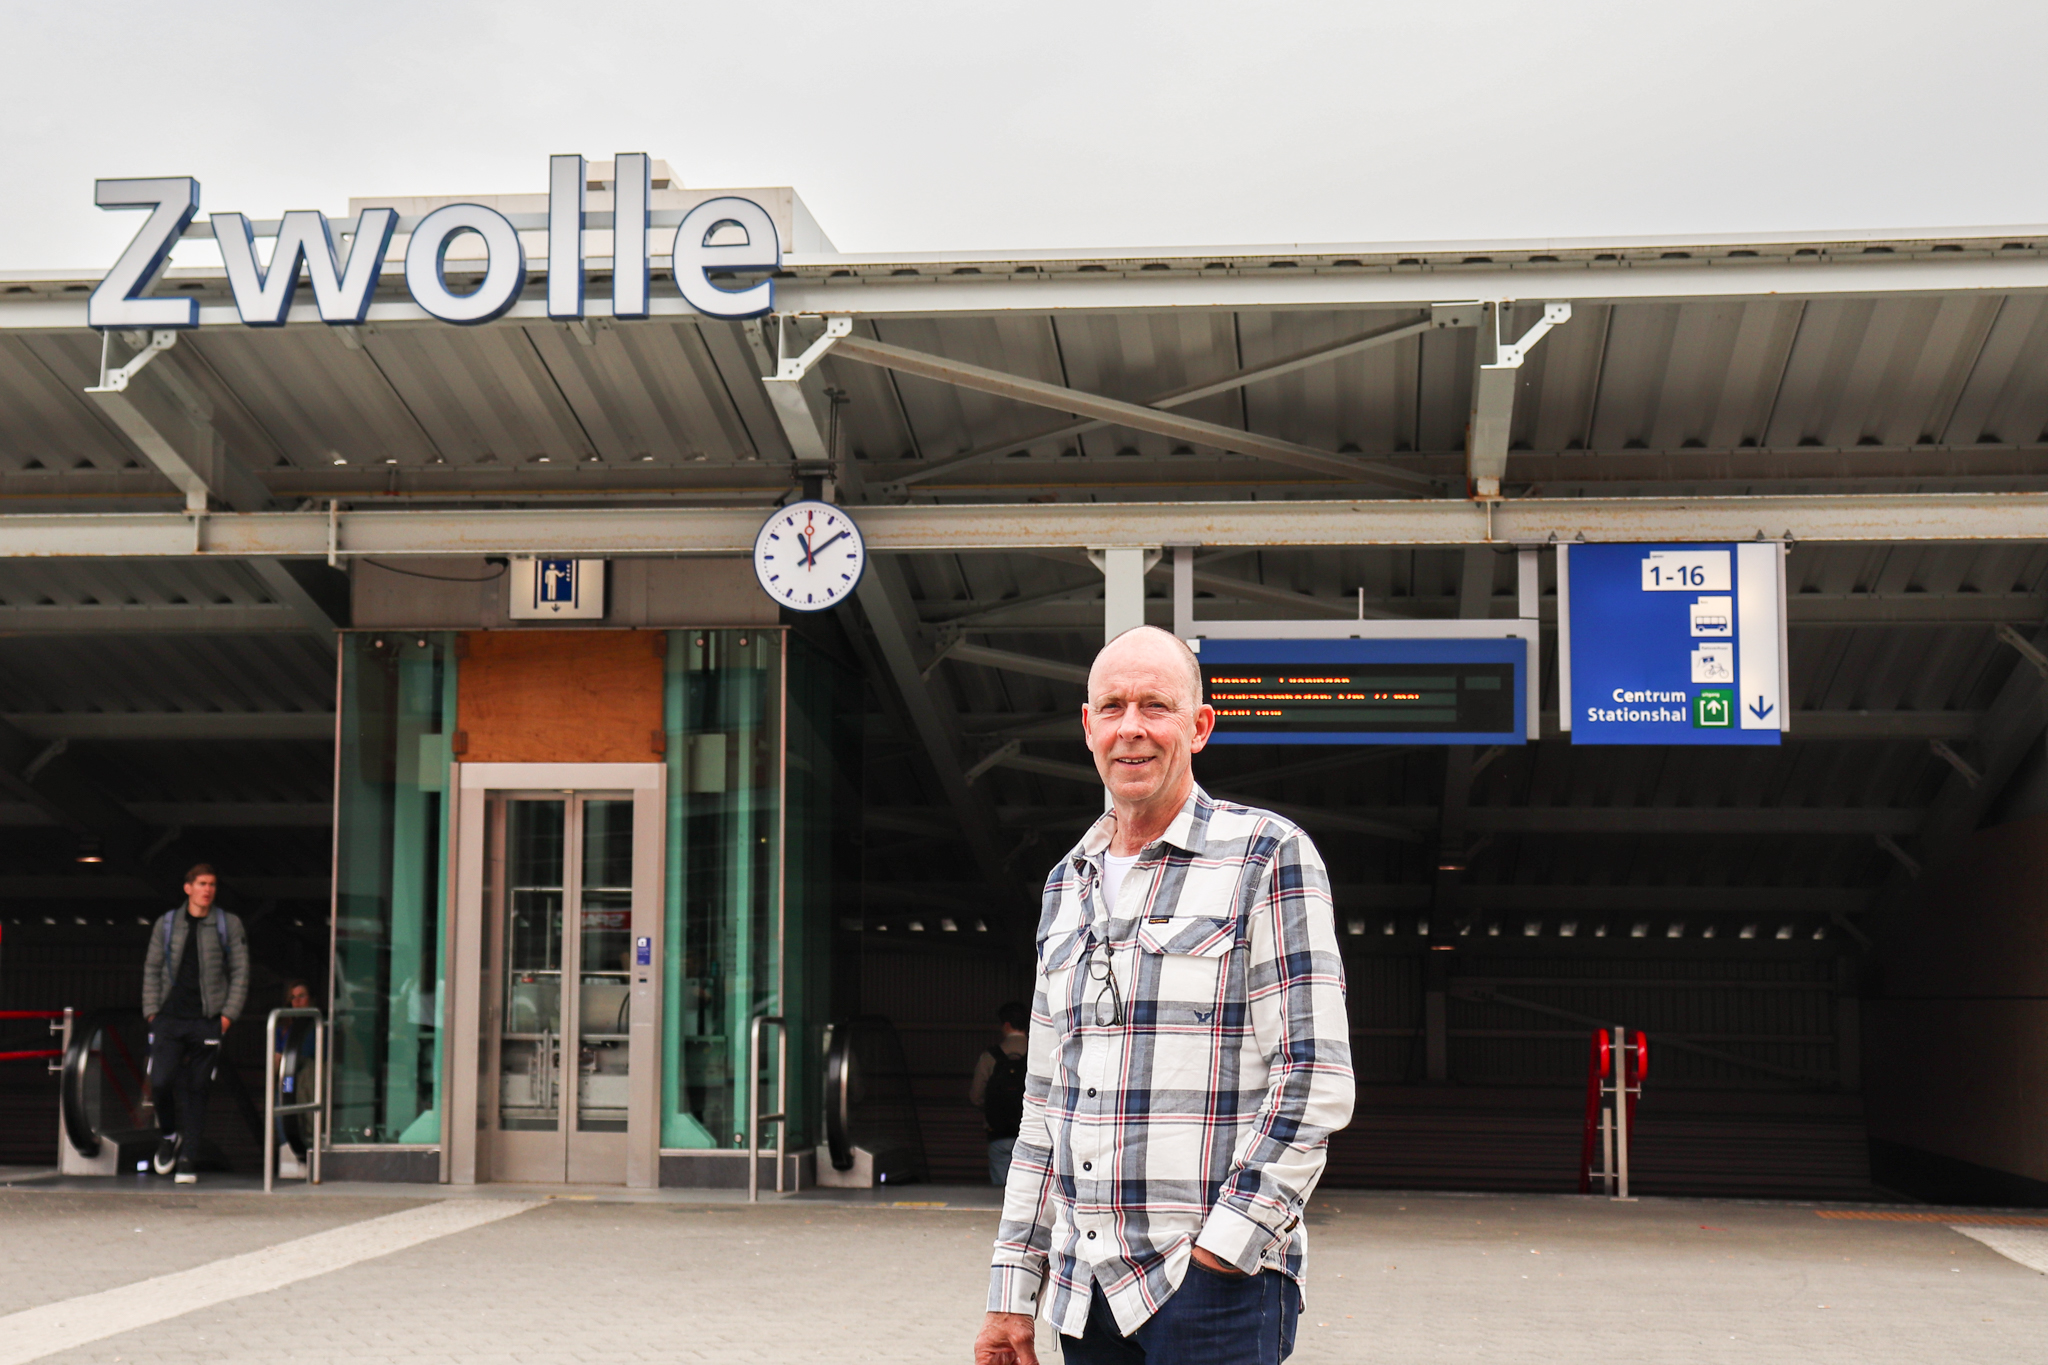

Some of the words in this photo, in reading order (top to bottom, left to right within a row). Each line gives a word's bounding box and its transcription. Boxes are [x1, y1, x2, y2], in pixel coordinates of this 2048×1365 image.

[87, 152, 781, 329] Zwolle
[1612, 688, 1686, 703] Centrum
[1587, 707, 1687, 722] Stationshal
